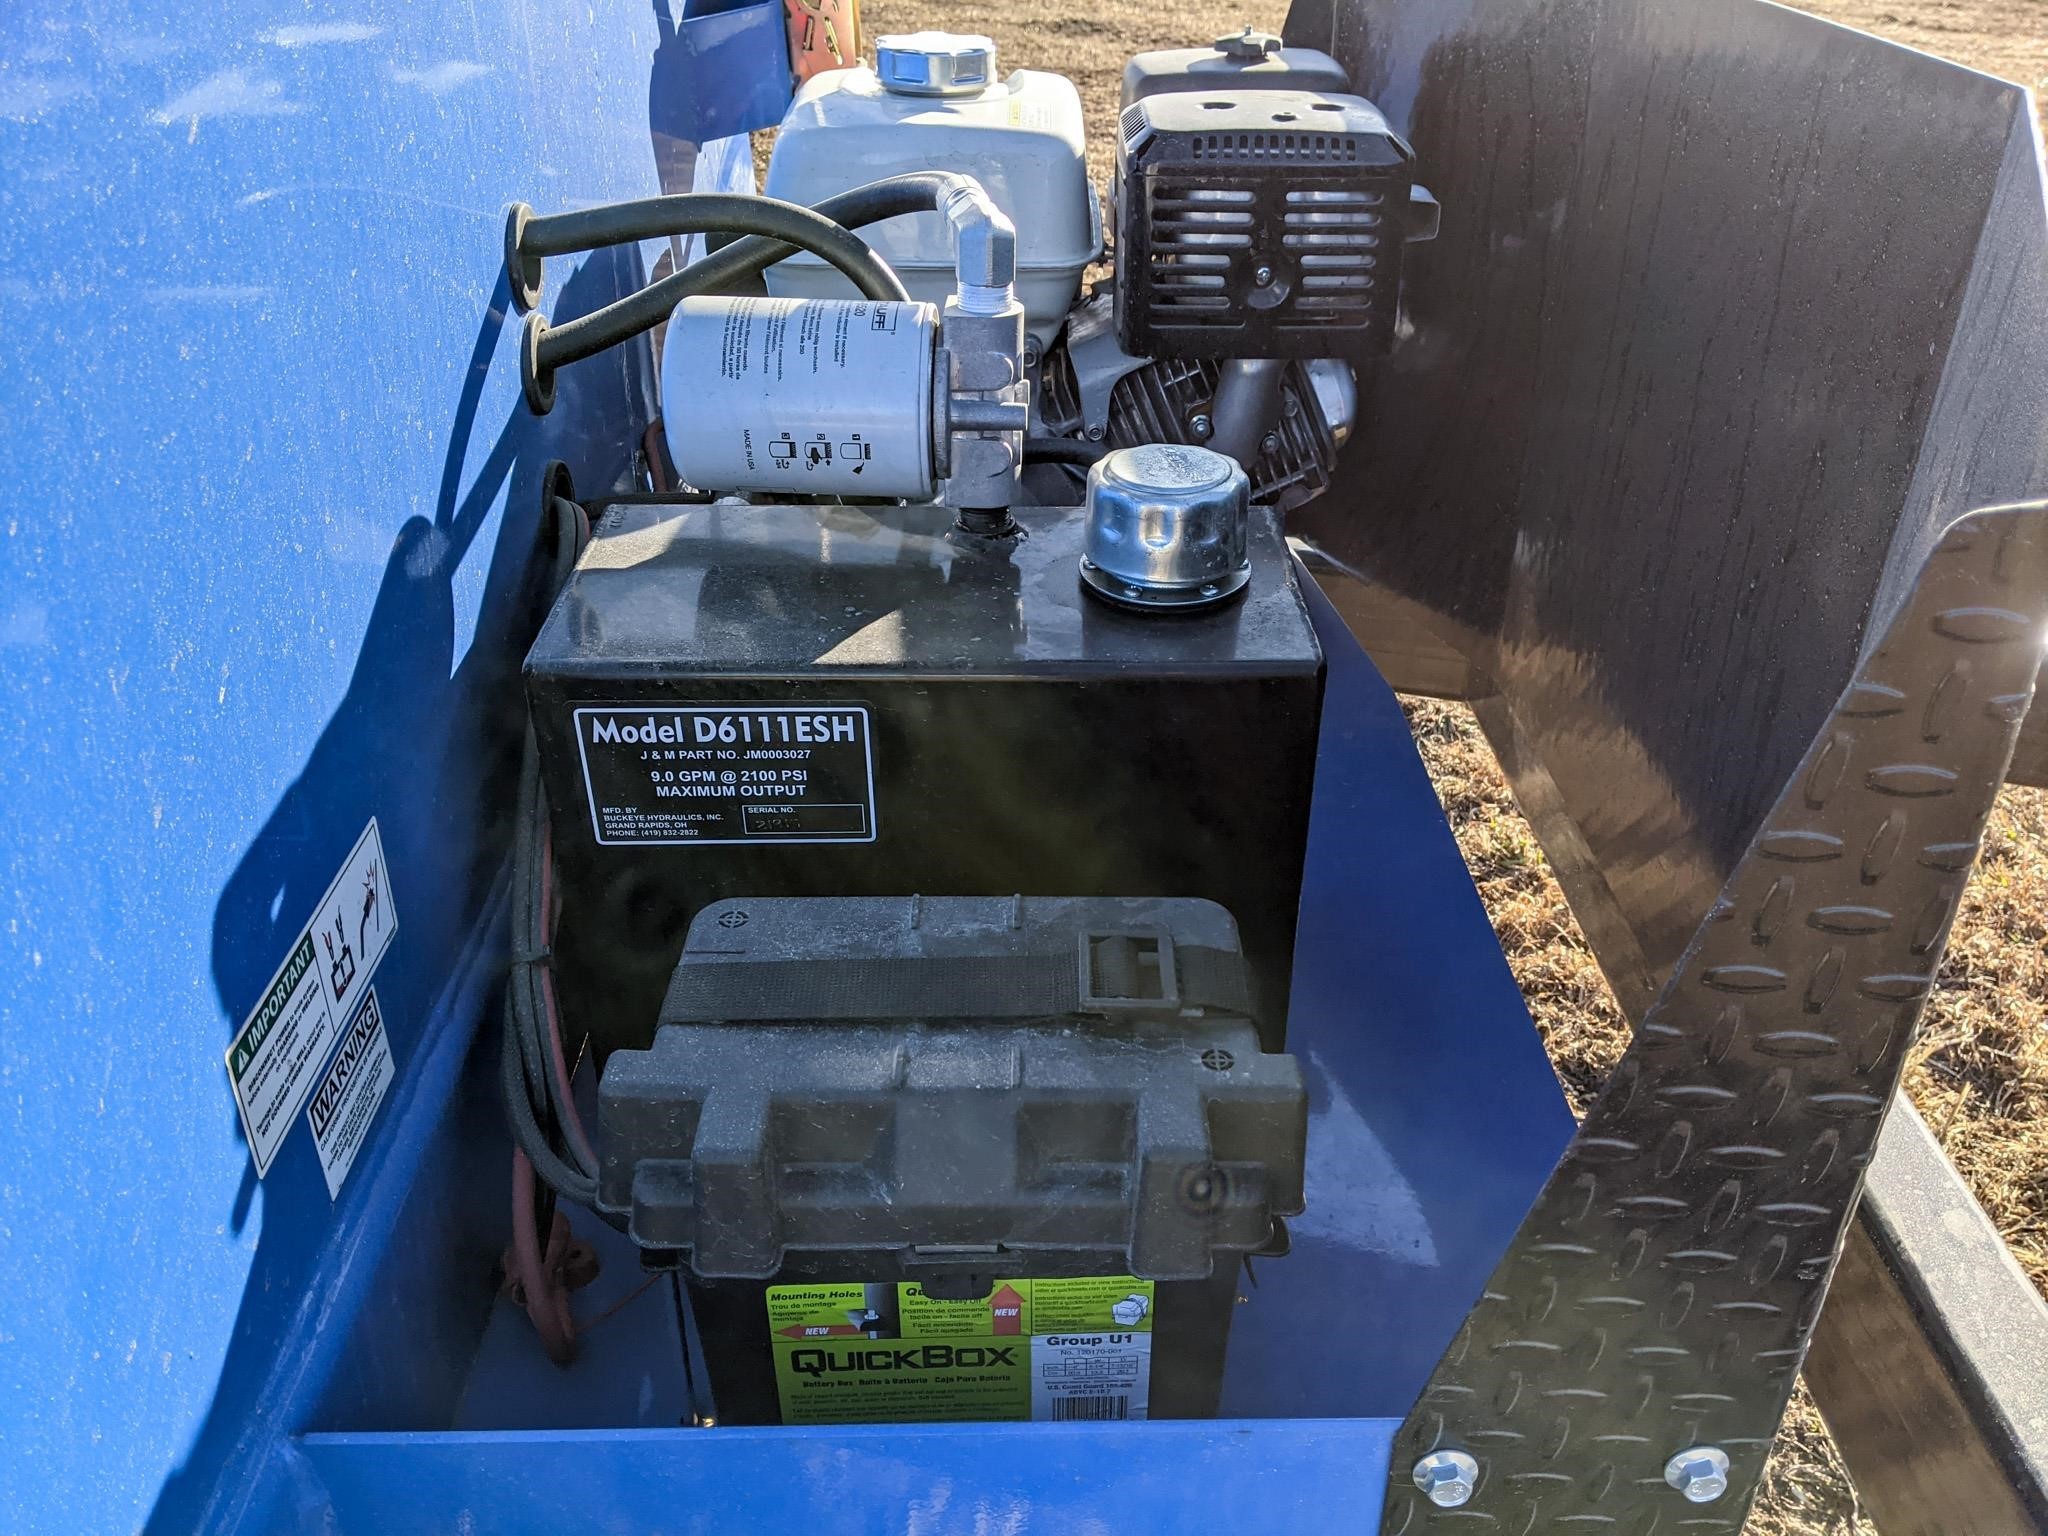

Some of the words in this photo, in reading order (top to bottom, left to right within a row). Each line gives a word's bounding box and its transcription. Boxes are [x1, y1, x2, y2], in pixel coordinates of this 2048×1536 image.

[743, 429, 751, 449] MADE
[745, 449, 753, 458] IN
[746, 458, 755, 471] USA
[592, 716, 684, 744] Model
[694, 715, 855, 743] D6111ESH
[640, 750, 649, 760] J
[651, 750, 662, 760] &
[664, 750, 676, 760] M
[679, 750, 713, 760] PART
[717, 750, 740, 760] NO.
[743, 749, 811, 760] JM0003027
[651, 771, 674, 783] 9.0
[678, 770, 716, 782] GPM
[720, 770, 738, 784] @
[740, 770, 777, 782] 2100
[781, 770, 808, 781] PSI
[656, 785, 736, 797] MAXIMUM
[740, 785, 806, 796] OUTPUT
[606, 829, 640, 837] PHONE:
[641, 829, 662, 837] (419)
[247, 939, 311, 1053] IMPORTANT
[247, 1072, 267, 1108] before
[276, 1018, 298, 1058] CHARGING
[300, 981, 319, 1015] WELDING
[247, 1043, 275, 1093] DISCONNECT
[274, 1018, 290, 1048] POWER
[312, 1003, 378, 1126] WARNING
[255, 1103, 272, 1136] Damage
[274, 1079, 285, 1101] scale
[283, 1058, 297, 1086] system
[295, 1042, 306, 1063] WILL
[314, 1013, 322, 1029] and
[319, 1106, 342, 1153] CALIFORNIA
[340, 1062, 364, 1112] PROPOSITION
[366, 1024, 382, 1059] WARNING
[261, 1117, 272, 1139] NOT
[270, 1083, 290, 1122] COVERED
[289, 1058, 304, 1088] UNDER
[326, 1146, 339, 1172] KNOWN
[347, 1110, 356, 1130] STATE
[359, 1071, 375, 1105] CALIFORNIA
[335, 1113, 350, 1144] PRODUCT
[771, 1291, 826, 1301] Mounting
[828, 1290, 863, 1299] Holes
[802, 1301, 837, 1309] montage
[993, 1308, 1019, 1317] NEW
[805, 1327, 830, 1336] NEW
[1046, 1336, 1103, 1347] Group
[1109, 1334, 1133, 1344] U1
